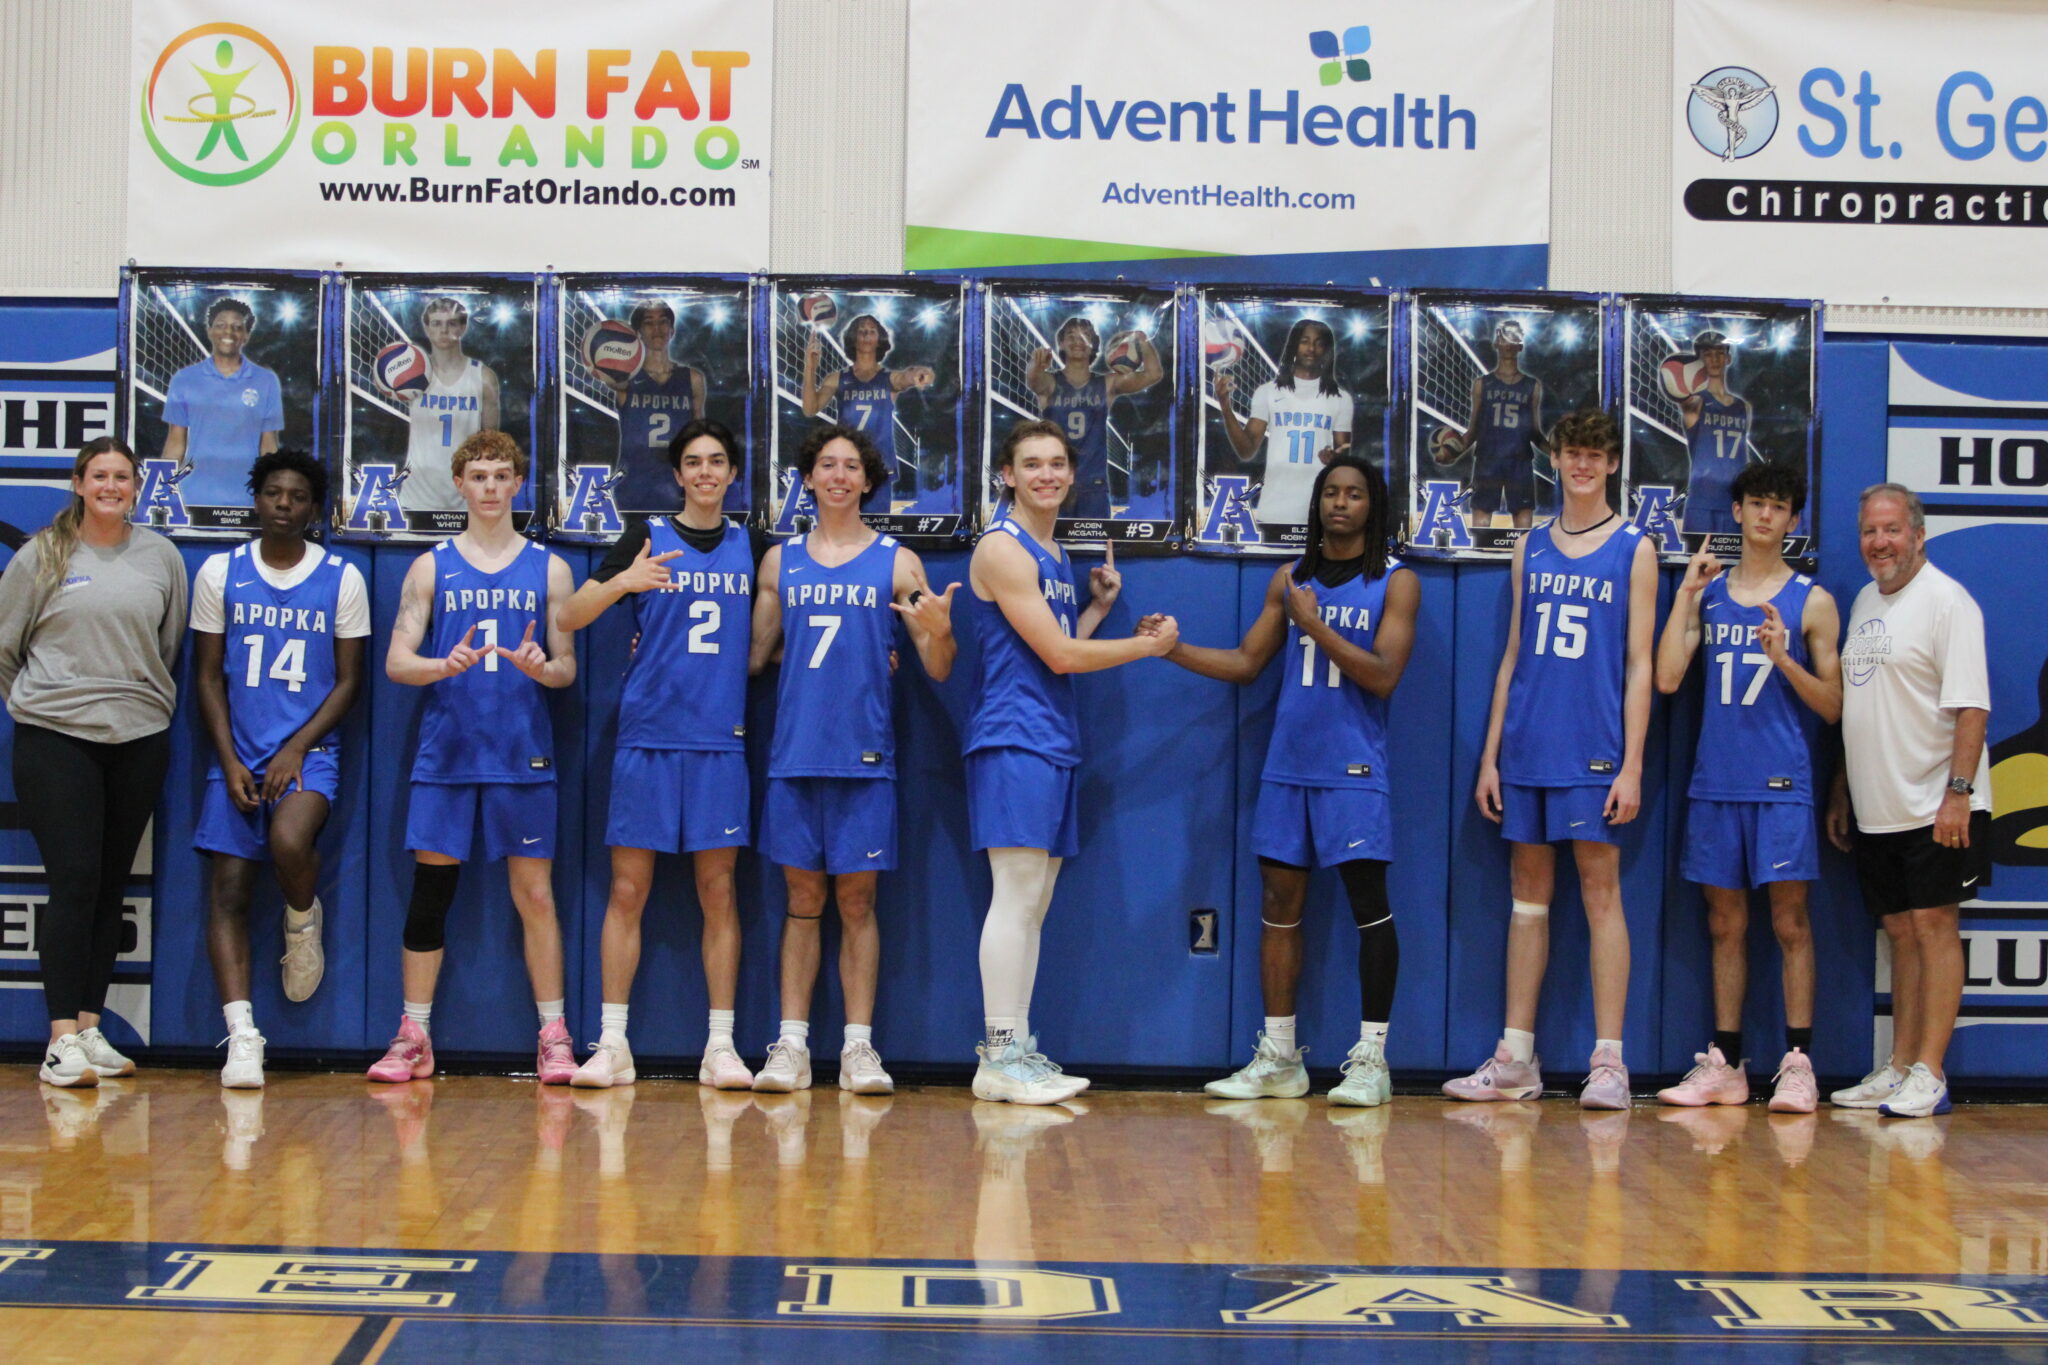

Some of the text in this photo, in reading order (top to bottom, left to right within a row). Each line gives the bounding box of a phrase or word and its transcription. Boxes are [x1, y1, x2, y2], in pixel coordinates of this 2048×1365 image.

[312, 45, 750, 121] BURN FAT
[985, 83, 1477, 151] AdventHealth
[1797, 67, 2048, 162] St. Ge
[311, 120, 760, 171] ORLANDO SM
[320, 177, 736, 207] www.BurnFatOrlando.com
[1102, 182, 1356, 211] AdventHealth.com
[603, 345, 632, 357] molten
[420, 394, 478, 411] APOPKA
[630, 393, 690, 410] APOPKA
[843, 388, 887, 401] APOPKA
[0, 400, 108, 449] HE
[855, 404, 872, 431] 7
[1067, 411, 1085, 440] 9
[1274, 412, 1332, 430] APOPKA
[1492, 402, 1520, 429] 15
[439, 414, 453, 447] 1
[648, 413, 671, 448] 2
[1712, 429, 1743, 460] 17
[1286, 430, 1315, 464] 11
[1939, 437, 2048, 487] HO
[212, 509, 250, 517] MAURICE
[220, 517, 241, 525] SIMS
[917, 517, 944, 532] #7
[1067, 529, 1107, 537] MCGATHA
[1126, 523, 1154, 538] #9
[1493, 538, 1515, 546] COTT
[1711, 536, 1740, 544] AEDYN
[444, 588, 537, 613] APOPKA
[787, 583, 878, 609] APOPKA
[1529, 572, 1613, 604] APOPKA
[233, 602, 327, 634] APOPKA
[688, 600, 721, 654] 2
[1535, 601, 1590, 660] 15
[477, 619, 499, 672] 1
[808, 615, 842, 669] 7
[1704, 623, 1790, 651] APOP
[1843, 635, 1893, 656] POPKA
[243, 634, 307, 693] 14
[1843, 656, 1886, 667] OLLEYBALL
[1715, 651, 1774, 706] 17
